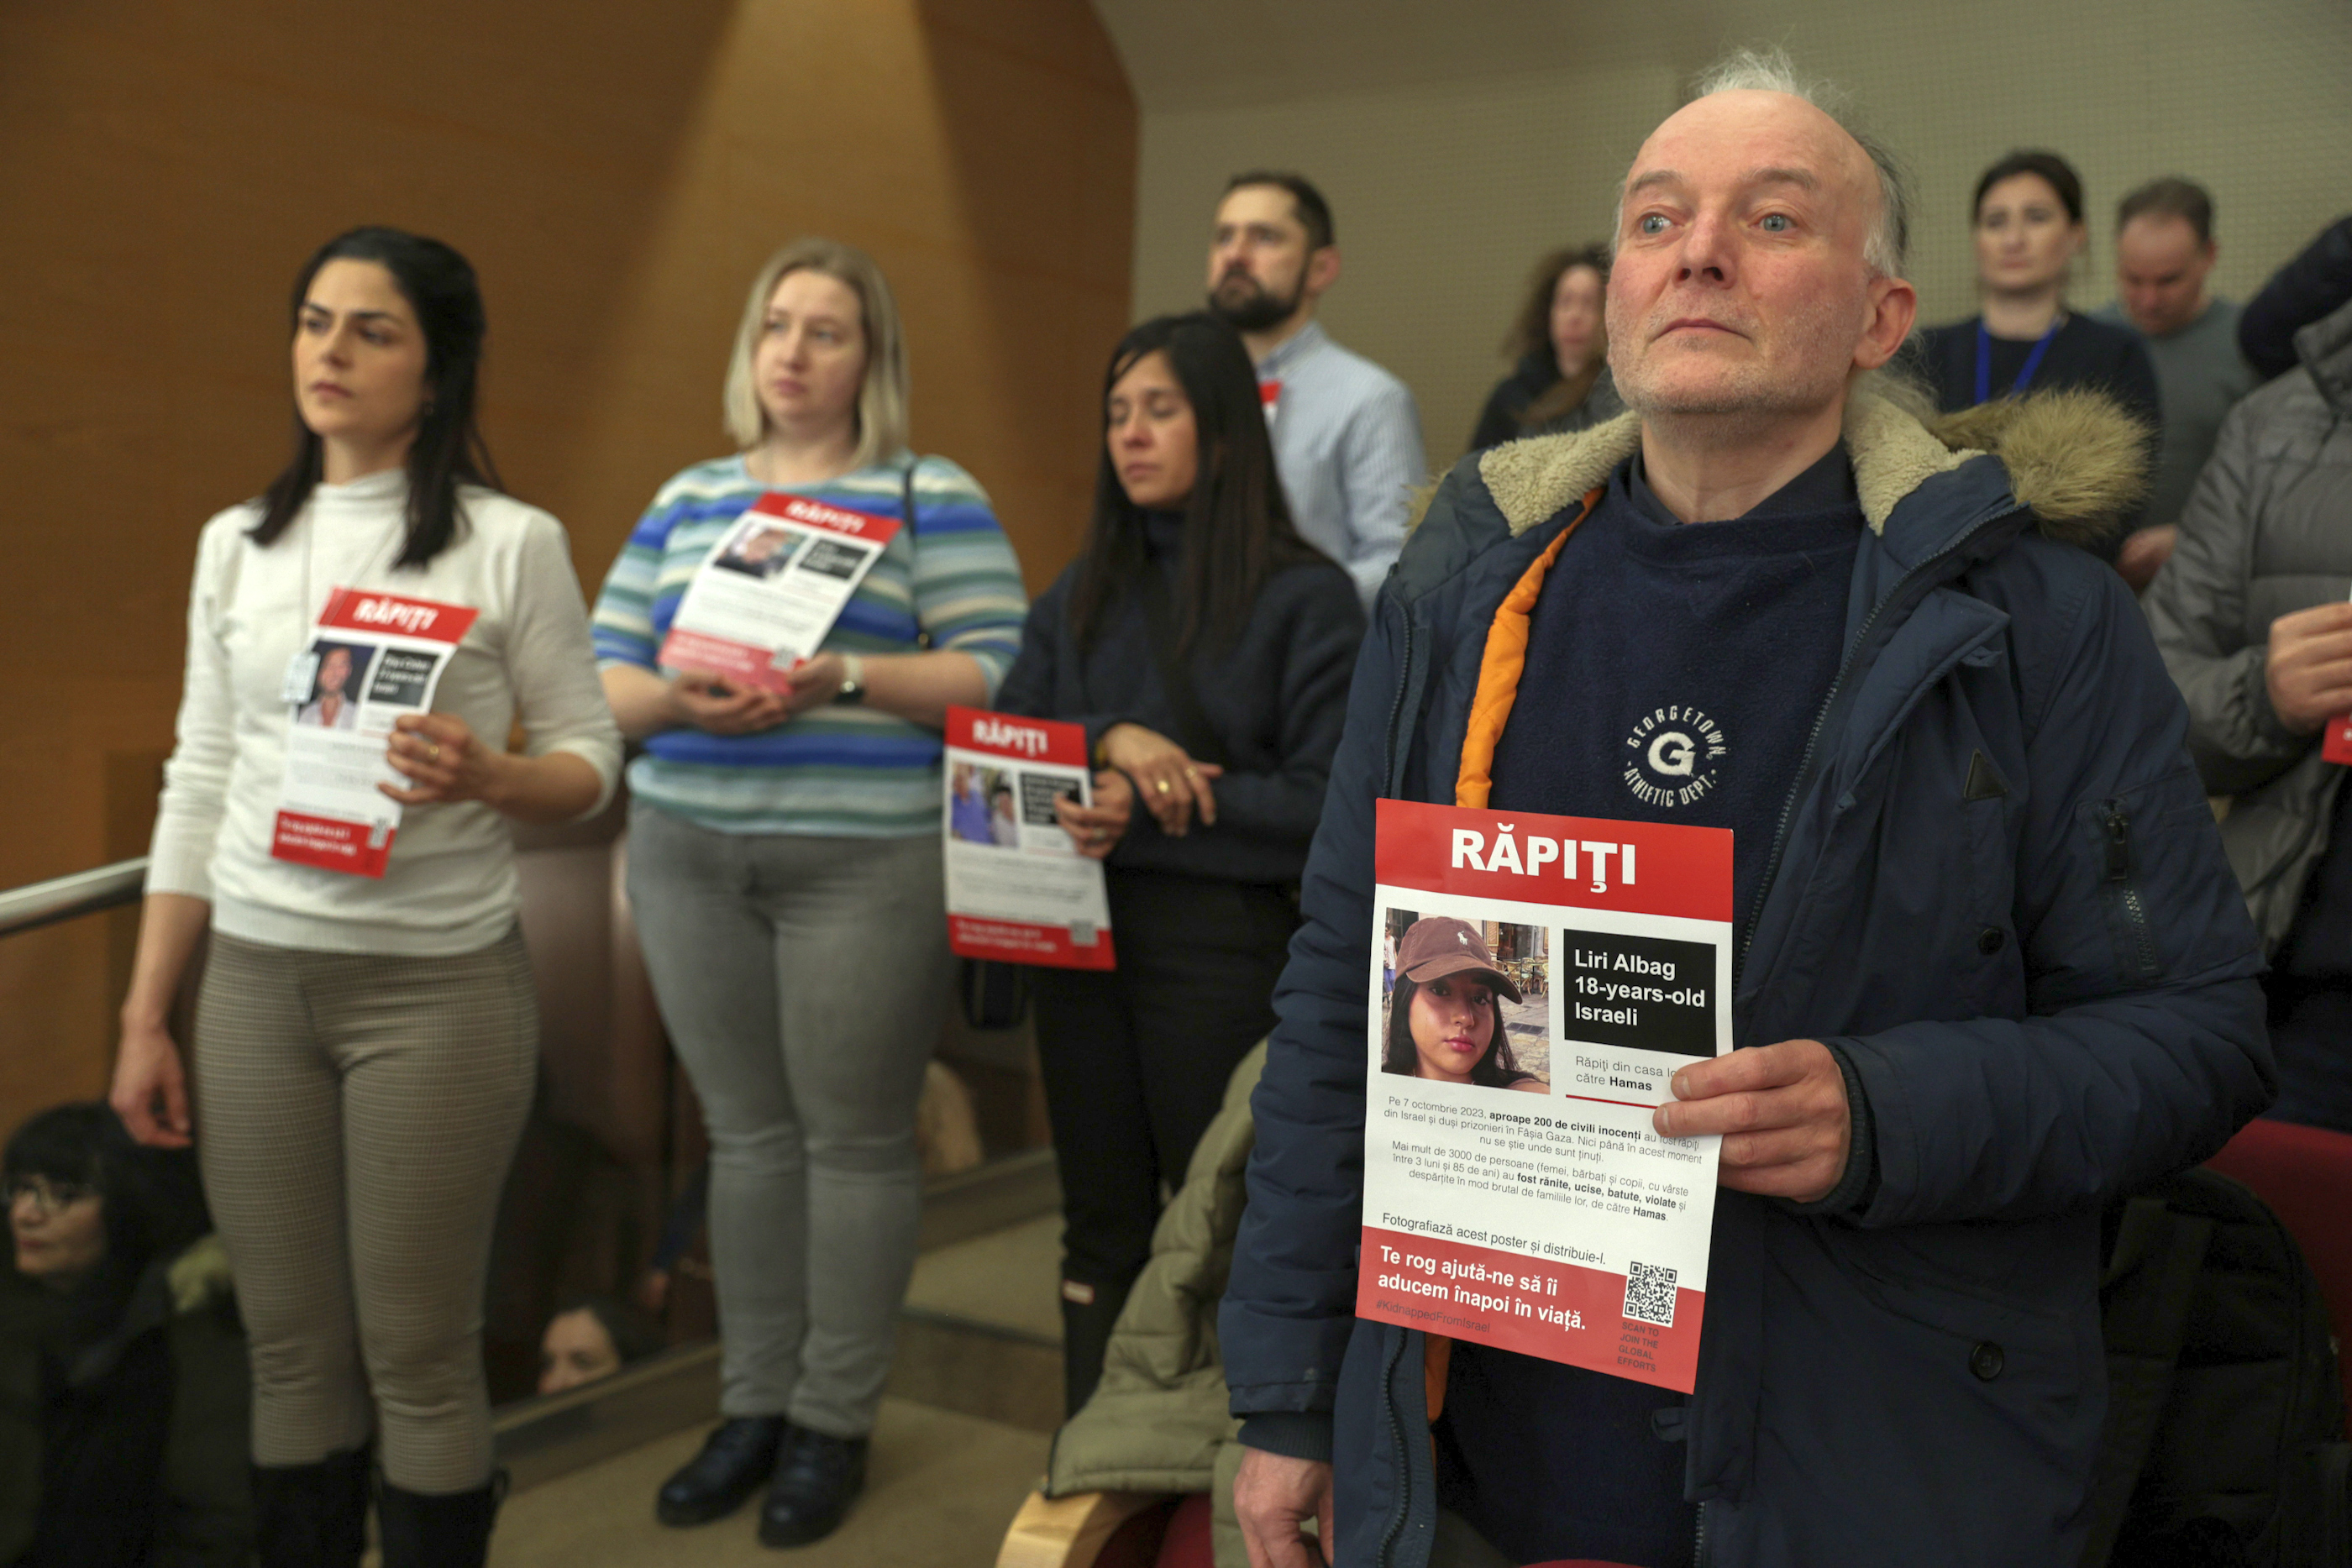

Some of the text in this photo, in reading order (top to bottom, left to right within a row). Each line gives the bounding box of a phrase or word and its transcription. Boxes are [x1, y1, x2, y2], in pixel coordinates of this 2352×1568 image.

[1627, 705, 1726, 754] GEORGETOWN
[1647, 732, 1696, 776] G
[1624, 768, 1674, 807] ATHLETIC
[1452, 822, 1635, 894] RĂPIŢI
[1575, 949, 1675, 981] Liri Albag
[1575, 976, 1705, 1008] 18-years-old
[1576, 1002, 1638, 1026] Israeli
[1576, 1073, 1652, 1091] către Hamas
[1613, 1062, 1630, 1072] din
[1635, 1065, 1663, 1077] casa
[1384, 1109, 1398, 1119] din
[1401, 1110, 1426, 1122] Israel
[1462, 1120, 1504, 1134] prizonieri
[1506, 1125, 1515, 1135] în
[1546, 1131, 1574, 1144] Gaza.
[1578, 1136, 1596, 1147] Nici
[1599, 1141, 1625, 1151] până
[1627, 1142, 1636, 1153] în
[1639, 1146, 1665, 1158] acest
[1667, 1151, 1702, 1164] moment
[1389, 1096, 1401, 1106] Pe
[1404, 1099, 1409, 1107] 7
[1412, 1099, 1457, 1114] octombrie
[1490, 1112, 1530, 1125] aproape
[1534, 1117, 1552, 1127] 200
[1556, 1120, 1567, 1130] de
[1571, 1122, 1595, 1134] civili
[1644, 1133, 1656, 1142] au
[1480, 1135, 1491, 1145] nu
[1494, 1139, 1505, 1147] se
[1528, 1143, 1552, 1154] unde
[1556, 1146, 1576, 1158] sunt
[1393, 1141, 1408, 1151] Mai
[1411, 1144, 1431, 1154] mult
[1435, 1147, 1446, 1156] de
[1448, 1149, 1472, 1161] 3000
[1475, 1153, 1487, 1162] de
[1490, 1156, 1534, 1171] persoane
[1537, 1162, 1569, 1177] (femei,
[1620, 1177, 1645, 1191] copii,
[1648, 1183, 1660, 1192] cu
[1662, 1184, 1688, 1197] vârste
[1393, 1154, 1413, 1164] între
[1416, 1157, 1421, 1166] 3
[1425, 1157, 1440, 1169] luni
[1453, 1163, 1465, 1172] 85
[1467, 1166, 1479, 1174] de
[1483, 1167, 1500, 1180] ani)
[1502, 1172, 1515, 1181] au
[1517, 1172, 1537, 1184] fost
[1539, 1177, 1571, 1191] rănite,
[1574, 1184, 1604, 1197] ucise,
[1608, 1188, 1642, 1204] batute,
[1645, 1194, 1677, 1209] violate
[1457, 1177, 1465, 1186] în
[1468, 1179, 1488, 1189] mod
[1492, 1182, 1519, 1194] brutal
[1522, 1188, 1534, 1198] de
[1591, 1199, 1604, 1209] de
[1606, 1202, 1630, 1214] către
[1633, 1206, 1668, 1221] Hamas.
[1383, 1213, 1453, 1235] Fotografiază
[1457, 1228, 1488, 1242] acest
[1490, 1233, 1527, 1249] poster
[1544, 1242, 1606, 1265] distribuie-l.
[1380, 1245, 1557, 1297] Te rog ajută-ne să îi
[1378, 1273, 1448, 1300] aducem
[1454, 1285, 1509, 1313] înapoi
[1515, 1298, 1532, 1317] în
[1376, 1298, 1490, 1333] #KidnappedFromIsrael
[1622, 1322, 1659, 1337] SCAN TO
[1619, 1345, 1653, 1360] GLOBAL
[1620, 1334, 1658, 1349] JOIN THE
[1618, 1356, 1656, 1372] EFFORTS
